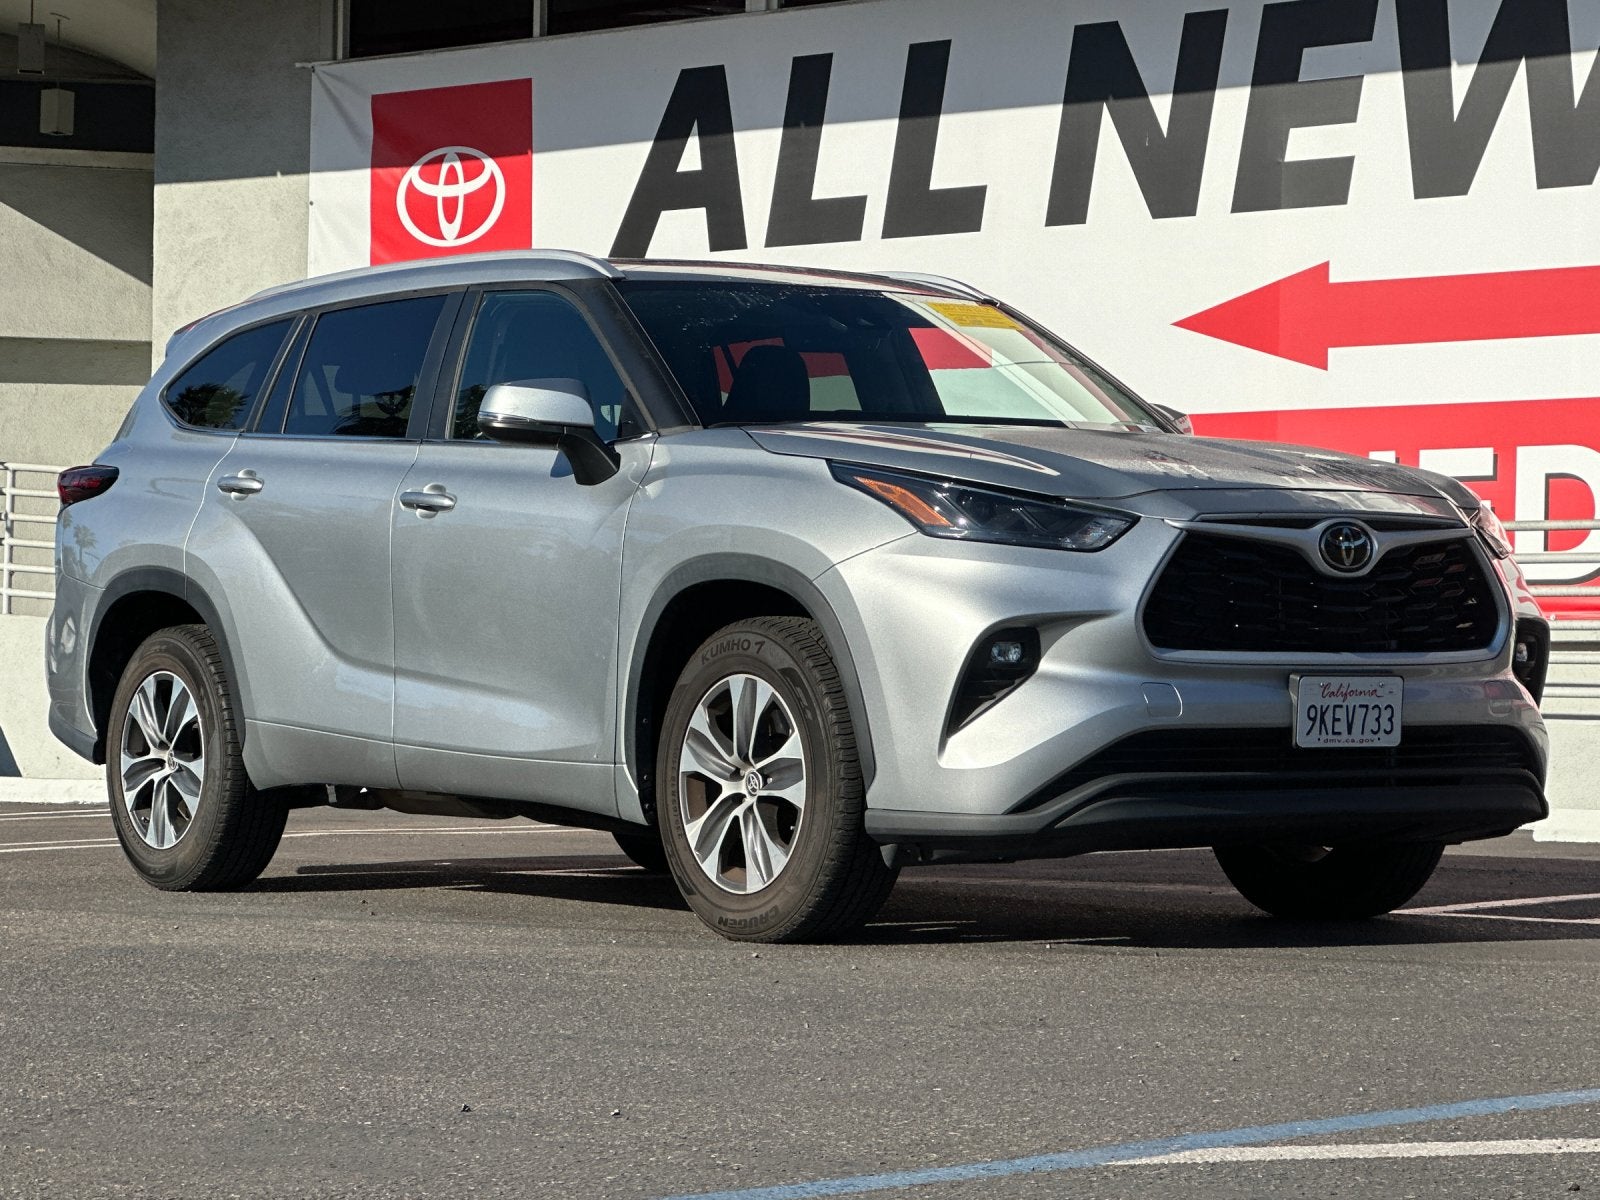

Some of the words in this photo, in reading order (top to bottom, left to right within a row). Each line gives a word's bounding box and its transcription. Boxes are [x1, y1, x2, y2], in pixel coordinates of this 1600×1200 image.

[609, 39, 988, 257] ALL
[1045, 0, 1600, 226] NEW
[701, 638, 751, 665] KUMHO
[1321, 682, 1384, 702] California
[1306, 703, 1395, 736] 9KEV733
